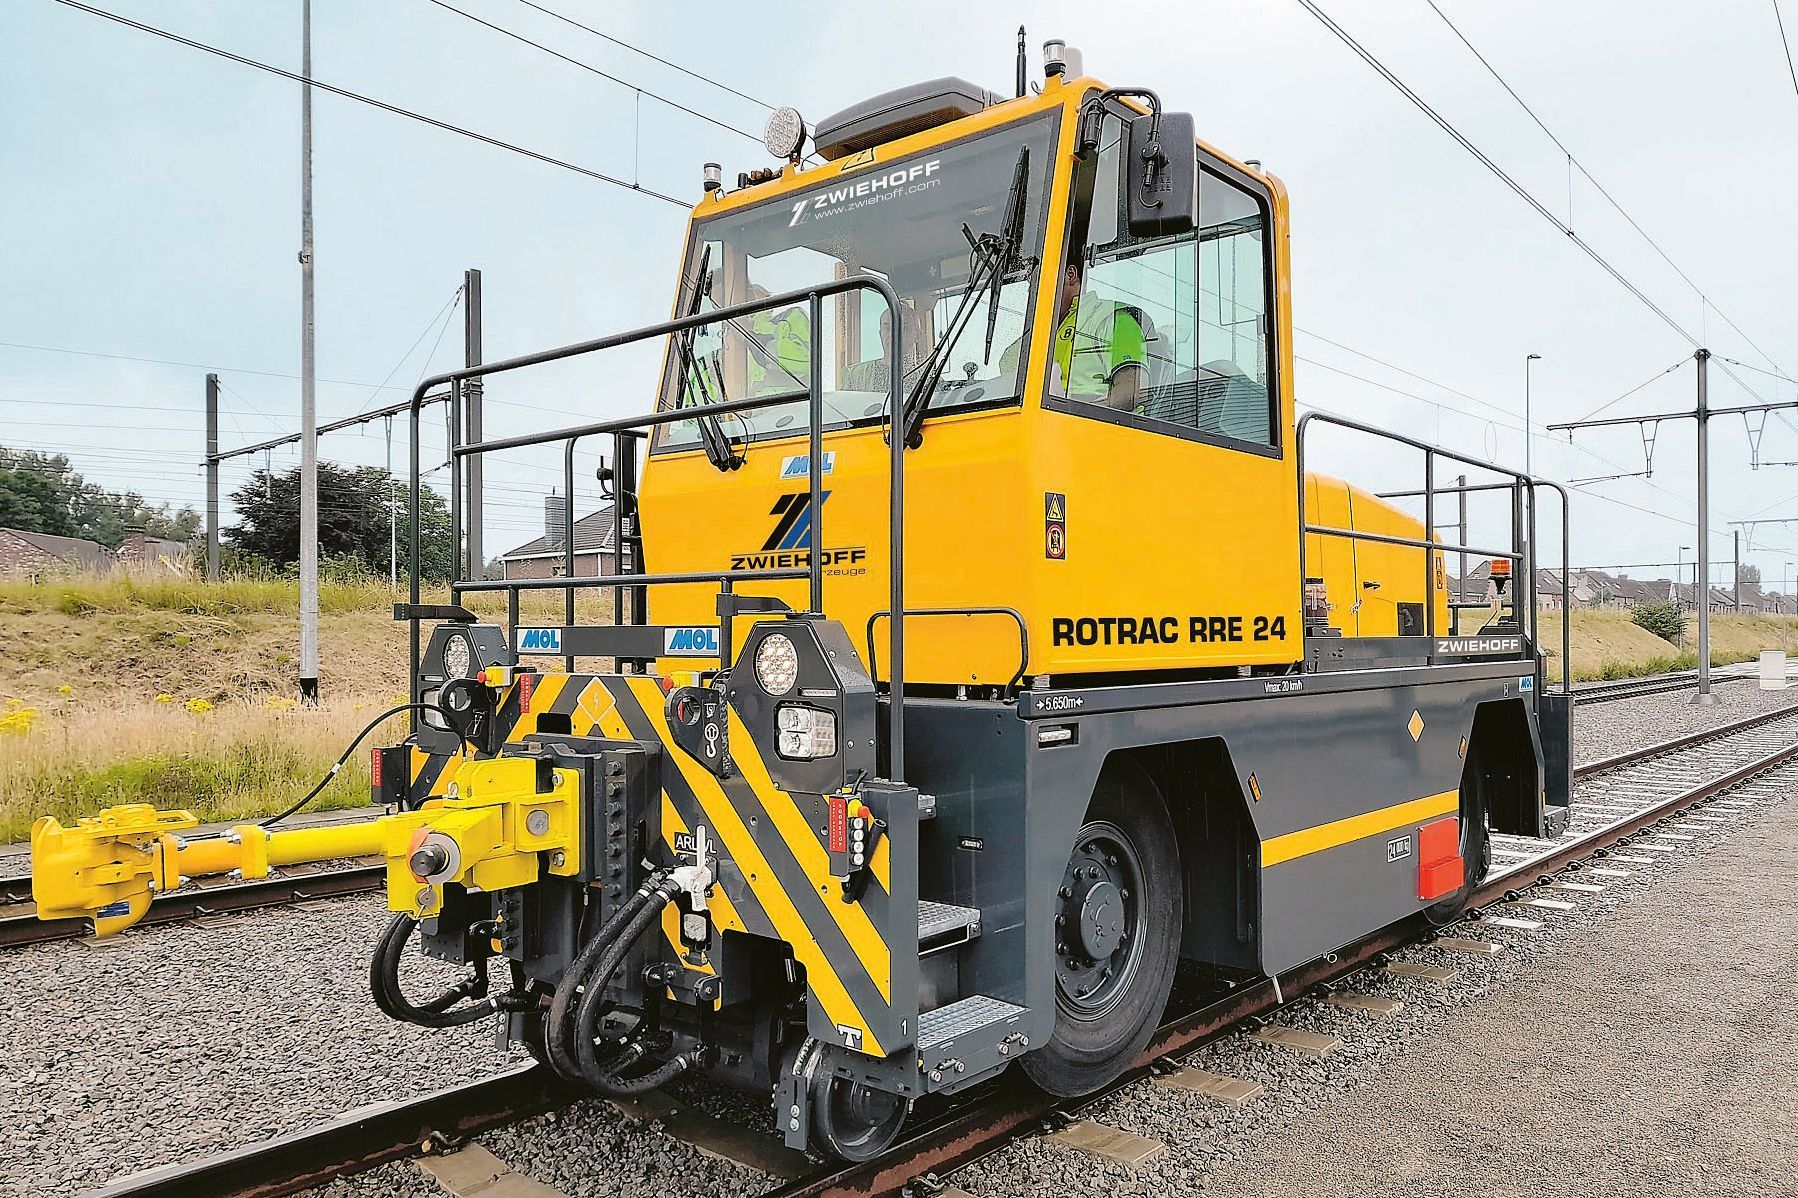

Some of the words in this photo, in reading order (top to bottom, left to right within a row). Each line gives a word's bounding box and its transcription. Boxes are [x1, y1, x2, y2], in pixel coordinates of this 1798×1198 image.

[814, 160, 941, 209] ZWIEHOFF
[814, 178, 941, 221] www.zwiehoff.com
[785, 453, 832, 474] ML
[521, 630, 560, 648] MOL
[669, 629, 717, 650] MOL
[1053, 616, 1179, 646] ROTRAC
[1189, 616, 1243, 643] RRE
[1253, 616, 1286, 641] 24
[1438, 639, 1519, 653] ZWIEHOFF
[1282, 680, 1290, 691] 20
[1045, 695, 1076, 711] 5.650m
[901, 1019, 907, 1036] 1
